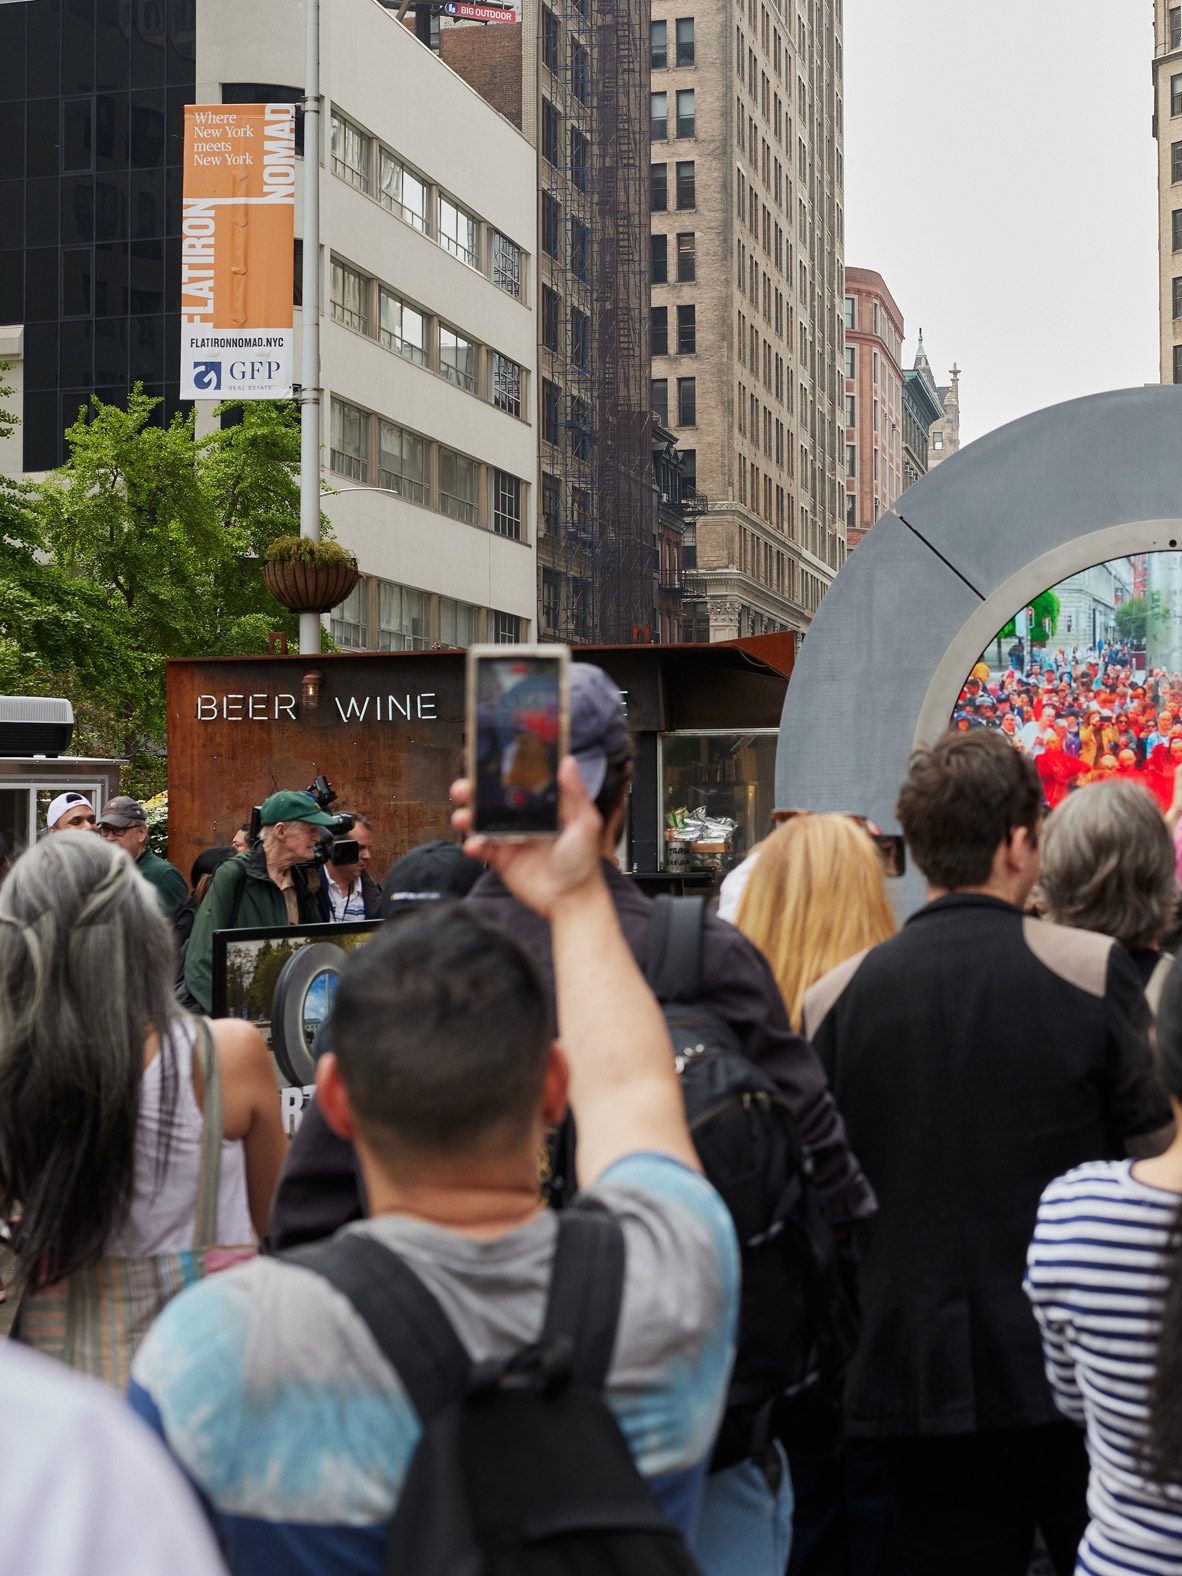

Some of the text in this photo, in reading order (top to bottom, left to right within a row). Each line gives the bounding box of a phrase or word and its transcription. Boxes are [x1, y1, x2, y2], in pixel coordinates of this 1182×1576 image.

[461, 6, 512, 21] BIG OUTDOOR
[194, 111, 237, 124] Where
[193, 125, 254, 138] New York
[193, 141, 232, 152] meets
[263, 103, 296, 204] NOMAD
[193, 153, 253, 166] New York
[181, 197, 216, 330] FLATIRON
[190, 337, 284, 348] FLATIRONNOMAD.NYC
[229, 361, 281, 381] GFP
[197, 692, 437, 723] BEER WINE
